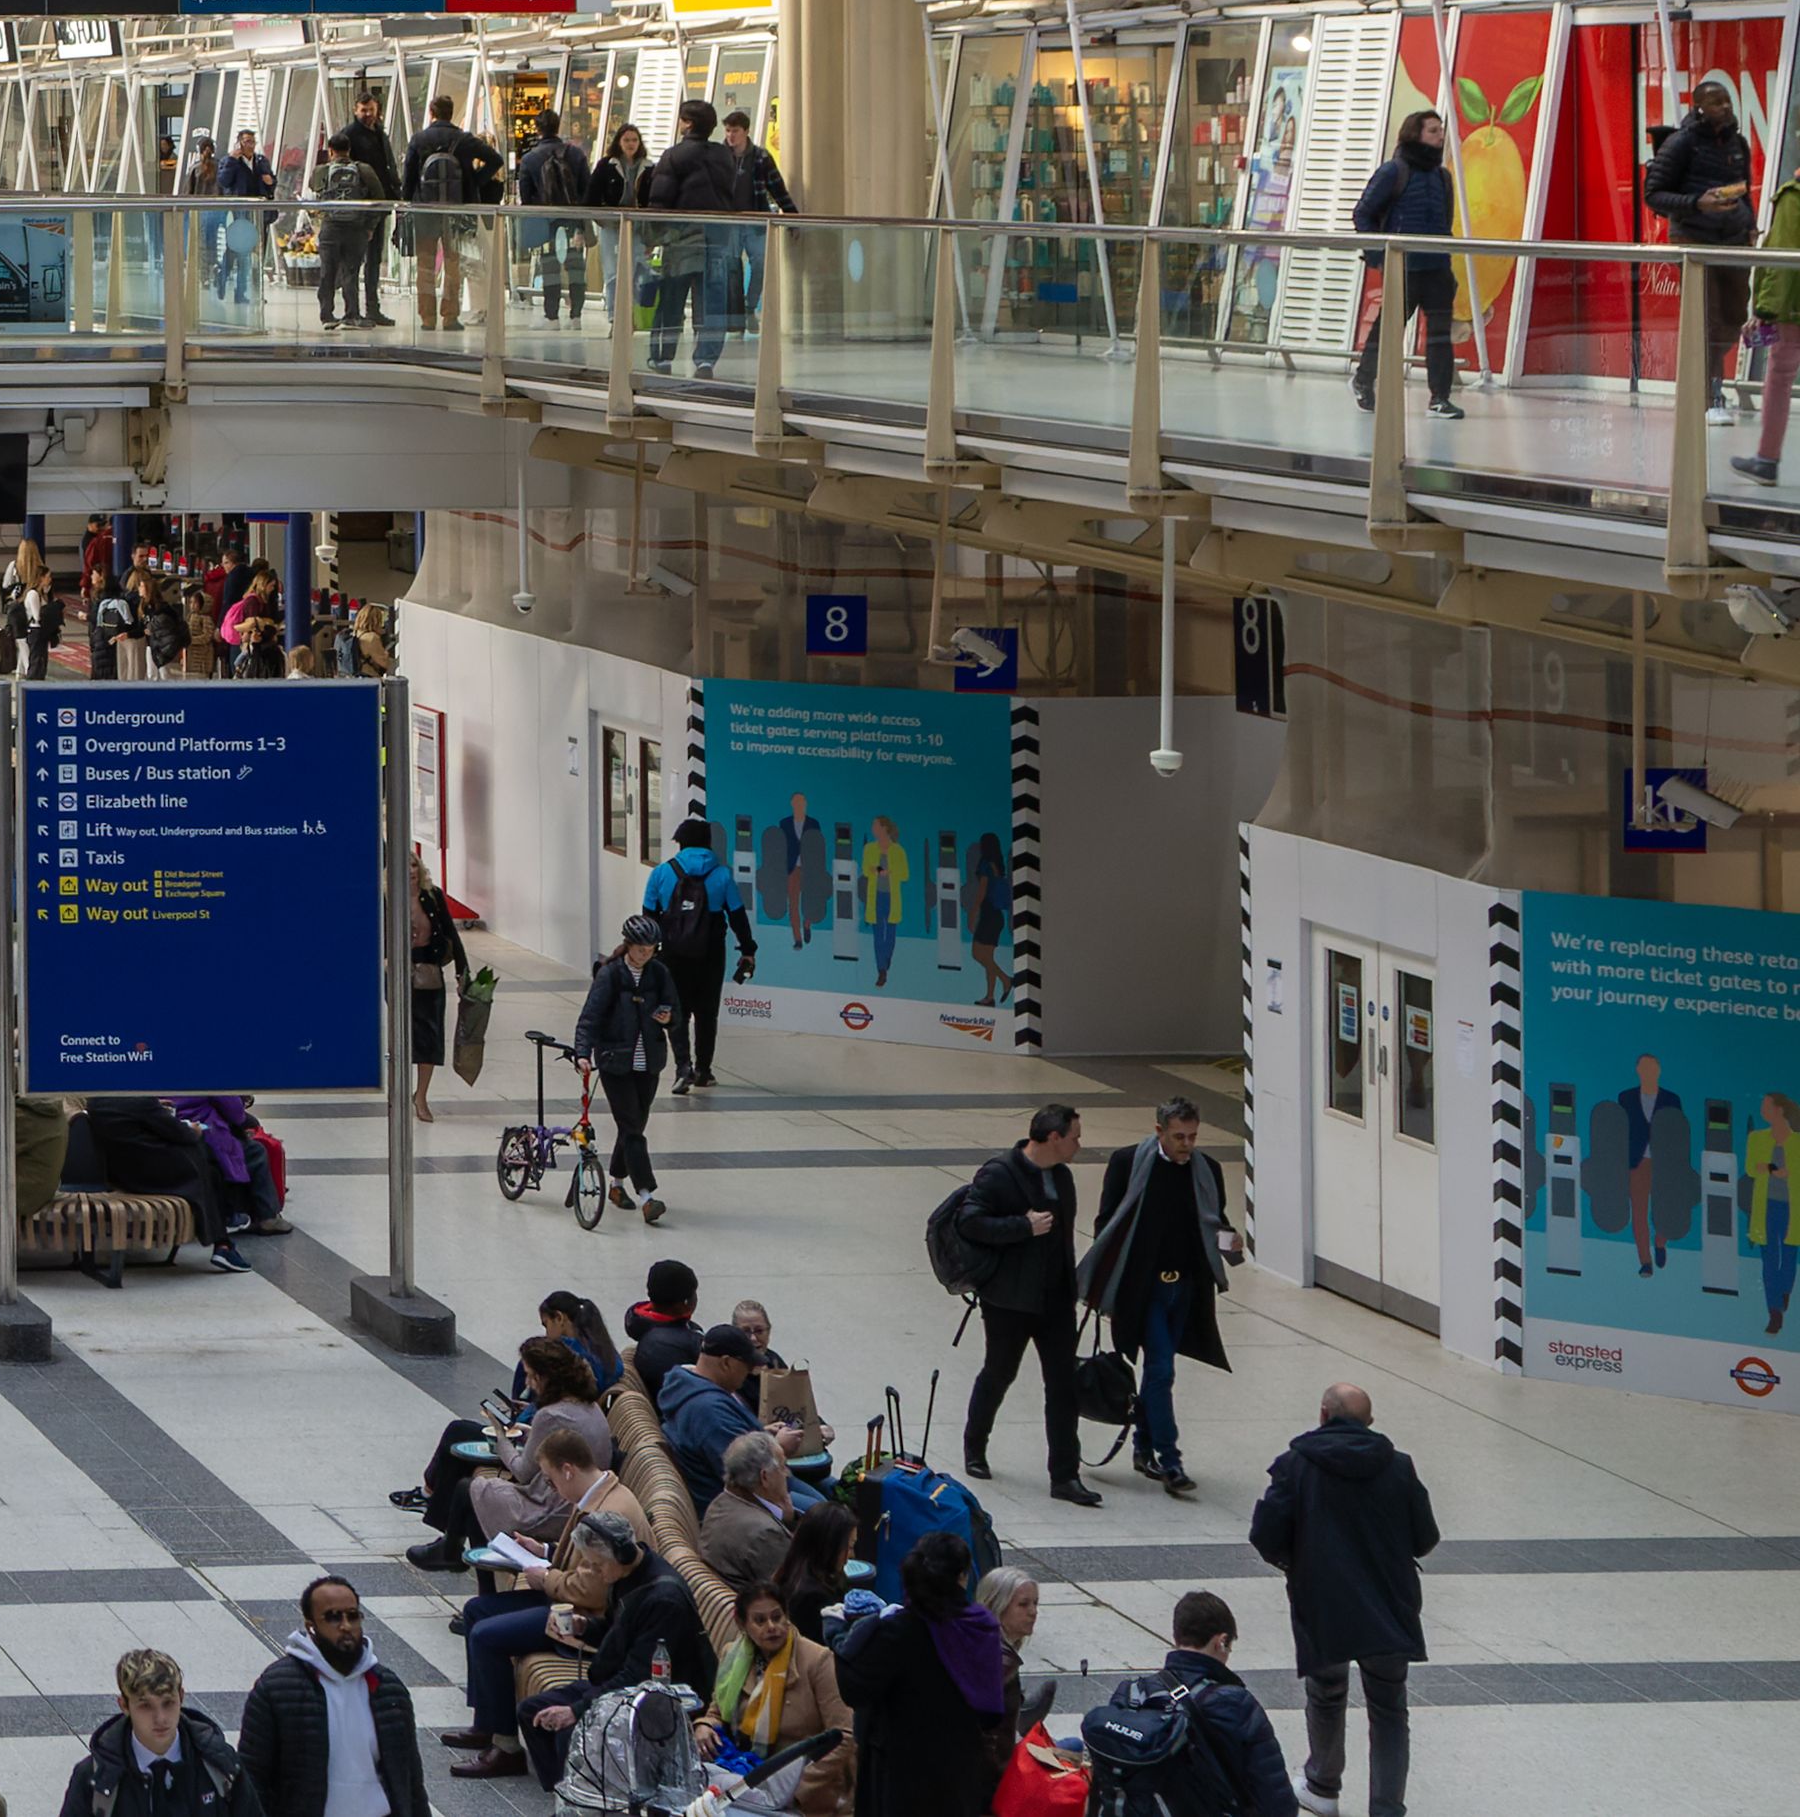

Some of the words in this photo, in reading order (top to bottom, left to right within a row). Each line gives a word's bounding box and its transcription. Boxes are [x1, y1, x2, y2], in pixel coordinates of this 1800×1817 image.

[825, 606, 849, 642] 8
[85, 710, 185, 726] Underground
[730, 703, 765, 717] We're
[768, 708, 810, 723] adding
[813, 711, 845, 722] more
[848, 712, 878, 724] wide
[881, 715, 922, 727] access
[730, 722, 764, 735] ticket
[766, 725, 800, 739] gates
[803, 727, 847, 743] serving
[850, 730, 912, 746] platforms
[915, 733, 943, 747] 1-10
[85, 737, 176, 754] Overground
[179, 737, 253, 752] Platforms
[257, 737, 287, 751] 1-3
[730, 740, 743, 752] to
[746, 742, 795, 755] improve
[798, 745, 873, 762] accessibility
[876, 749, 893, 761] for
[896, 751, 957, 767] everyone.
[85, 766, 130, 781] Buses
[134, 766, 142, 781] /
[146, 766, 174, 780] Bus
[178, 765, 231, 780] station
[85, 794, 156, 809] Elizabeth
[160, 794, 188, 808] line
[86, 822, 113, 837] Lift
[116, 827, 136, 838] Way
[138, 828, 158, 838] out,
[160, 826, 222, 838] Underground
[224, 826, 242, 836] and
[244, 826, 262, 836] Bus
[264, 825, 298, 836] station
[86, 850, 125, 866] Taxis
[164, 870, 177, 878] Old
[178, 870, 197, 878] Broad
[199, 870, 224, 878] Street
[85, 879, 118, 895] Way
[122, 879, 149, 893] out
[164, 880, 202, 889] Broadgate
[164, 889, 199, 899] Exchange
[201, 889, 226, 899] Square
[86, 906, 119, 923] Way
[122, 906, 149, 921] out
[153, 908, 198, 920] Liverpool
[199, 908, 210, 920] St
[1551, 931, 1605, 952] We're
[1610, 940, 1697, 964] replacing
[1702, 946, 1754, 965] these
[1759, 953, 1800, 971] reta
[1551, 959, 1591, 976] with
[1597, 964, 1645, 981] more
[1650, 967, 1704, 987] ticket
[1709, 974, 1762, 992] gates
[1767, 978, 1788, 995] to
[724, 997, 771, 1010] stansted
[1551, 984, 1593, 1002] your
[1597, 986, 1669, 1012] journey
[1674, 995, 1778, 1020] experience
[728, 1007, 771, 1019] express
[939, 1013, 996, 1027] NetworkRail
[60, 1034, 104, 1046] Connect
[107, 1034, 121, 1046] to
[60, 1051, 83, 1063] Free
[86, 1051, 126, 1063] Station
[128, 1050, 153, 1063] WiFi
[1548, 1340, 1623, 1362] stansted
[1555, 1354, 1623, 1374] express
[1105, 1721, 1144, 1741] HUUB
